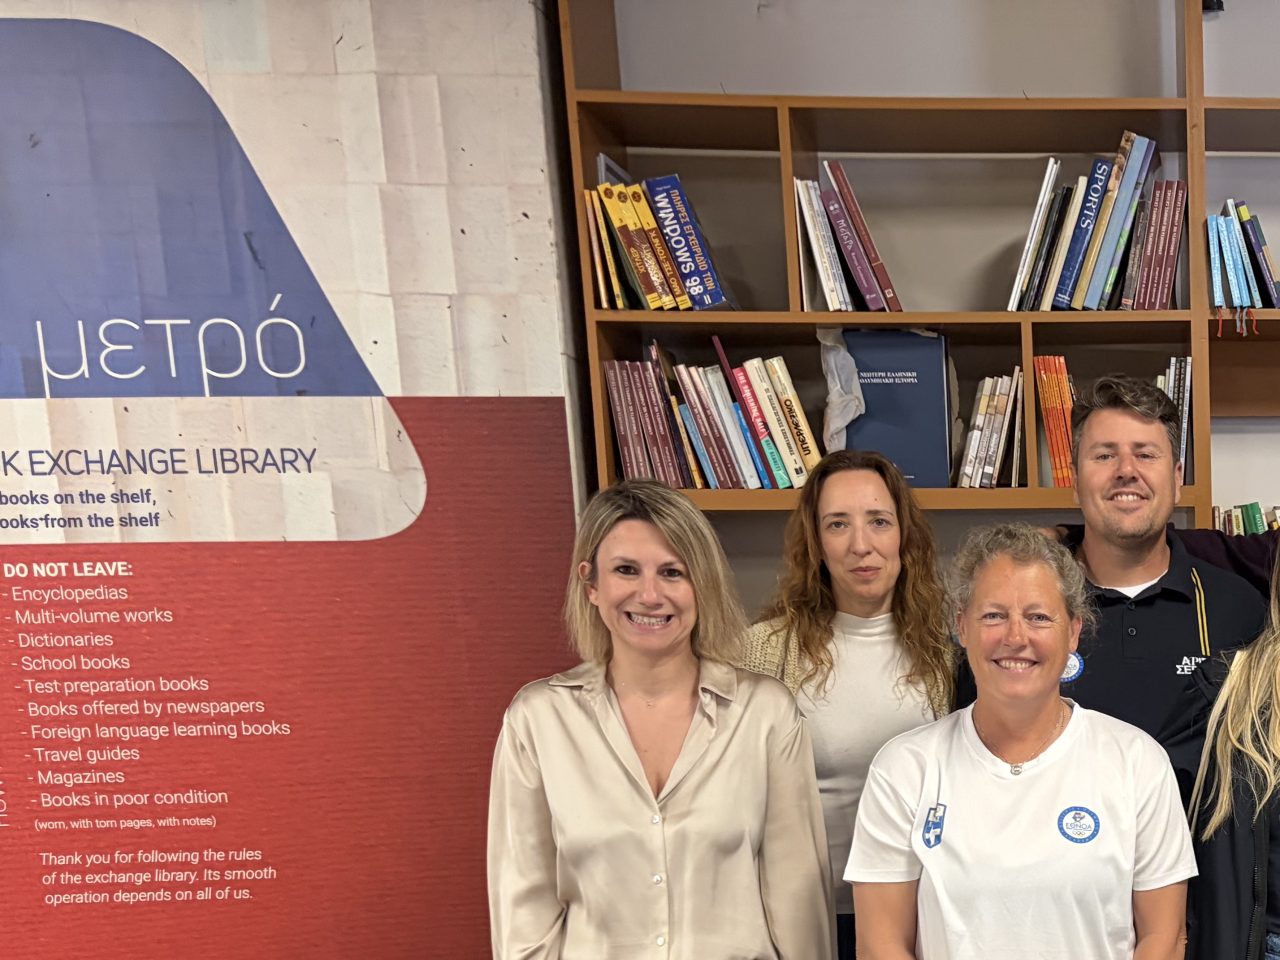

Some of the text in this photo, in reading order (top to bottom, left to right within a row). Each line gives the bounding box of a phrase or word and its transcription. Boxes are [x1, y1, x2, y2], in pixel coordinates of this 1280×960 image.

[1080, 163, 1109, 229] SPORTS
[655, 193, 694, 273] WINDOWS
[685, 277, 703, 296] 98
[670, 189, 715, 290] ΠΛΗΡΕΣ ΕΓΧΕΙΡΙΔΙΟ ΤΩΝ
[36, 293, 307, 399] μετρό
[28, 448, 189, 476] EXCHANGE
[196, 448, 317, 474] LIBRARY
[53, 493, 74, 505] on
[78, 491, 106, 504] the
[110, 489, 157, 506] shelf,
[43, 515, 83, 528] from
[87, 514, 114, 528] the
[119, 512, 161, 528] shelf
[4, 562, 132, 577] DO NOT LEAVE:
[12, 586, 128, 604] Encyclopedias
[16, 608, 173, 624] Multi-volume works
[18, 632, 113, 647] Dictionaries
[22, 655, 130, 670] School books
[24, 677, 208, 696] Test preparation books
[28, 700, 264, 717] Books offered by newspapers
[31, 721, 290, 741] Foreign language learning books
[34, 747, 139, 764] Travel guides
[38, 770, 124, 787] Magazines
[41, 790, 228, 808] Books in poor condition
[35, 816, 216, 832] (worn, with torn pages, with notes)
[40, 848, 261, 867] Thank you for following the rules
[43, 867, 276, 885] of the exchange library. Its smooth
[45, 887, 252, 906] operation depends on all of us.
